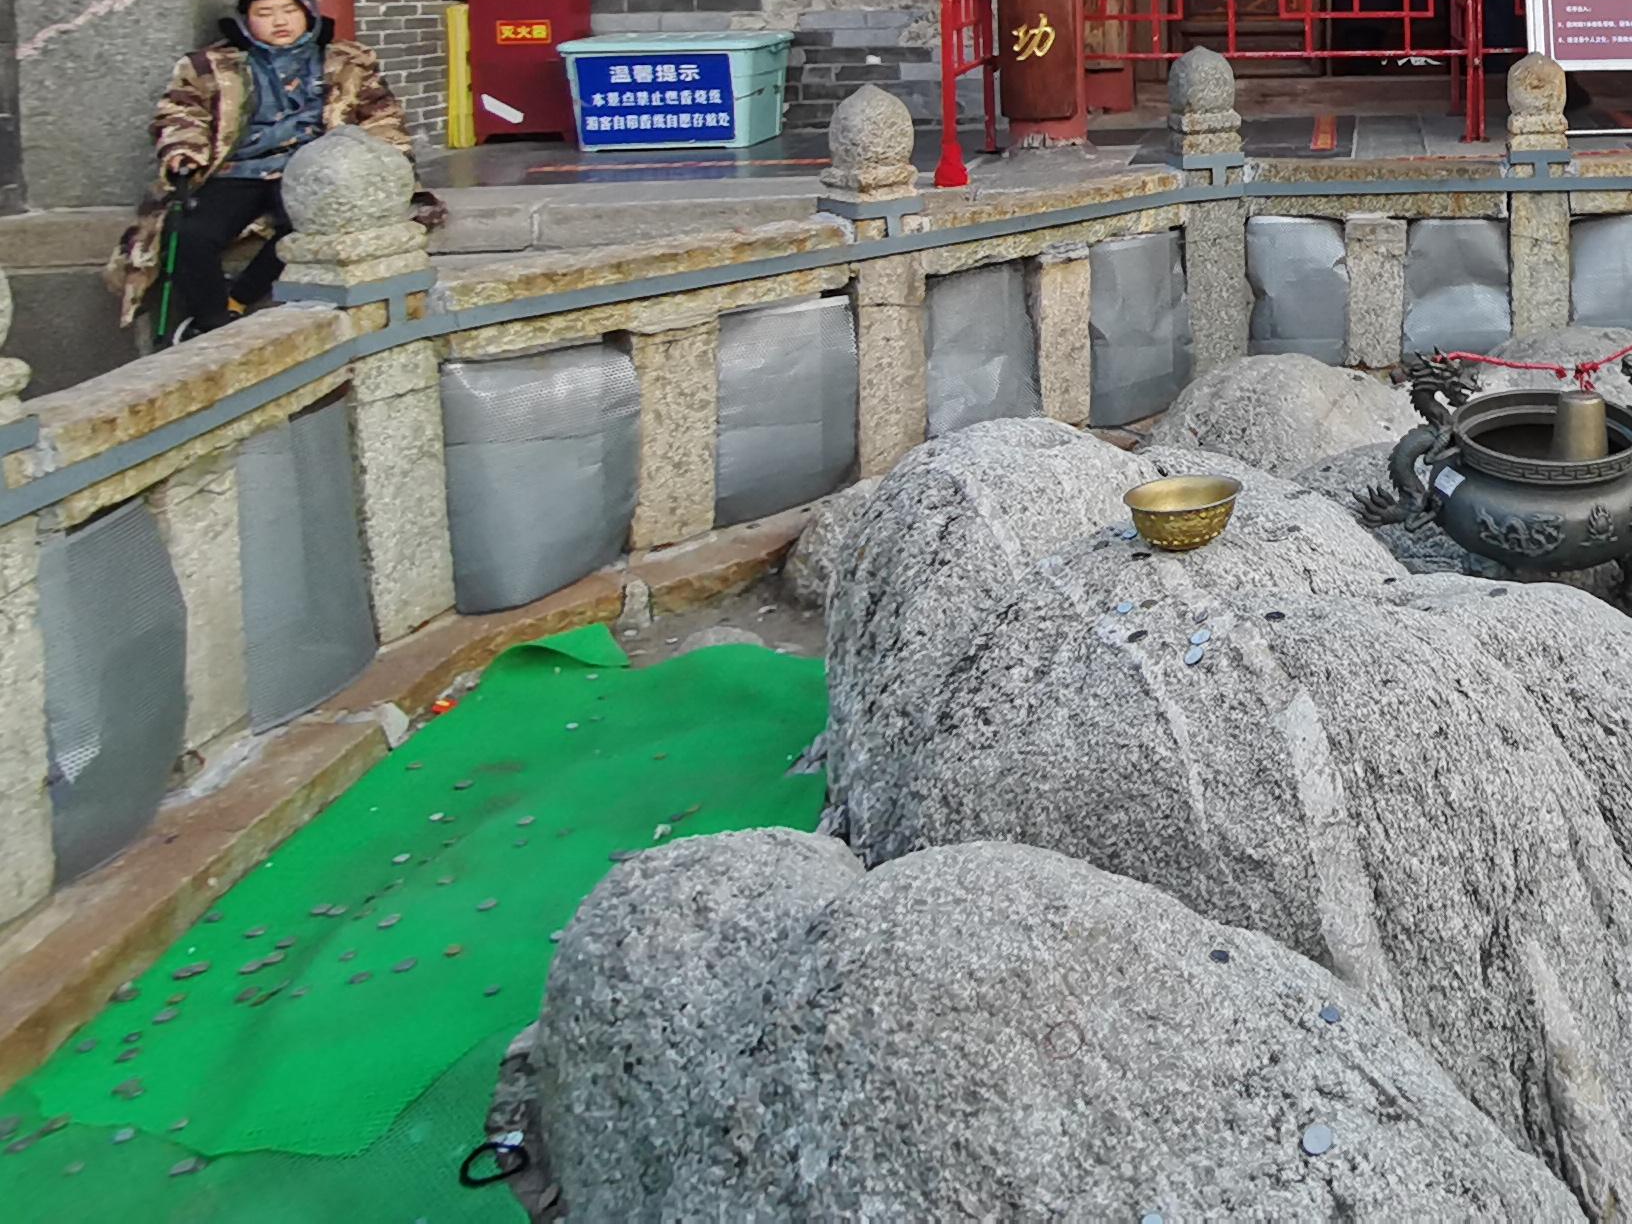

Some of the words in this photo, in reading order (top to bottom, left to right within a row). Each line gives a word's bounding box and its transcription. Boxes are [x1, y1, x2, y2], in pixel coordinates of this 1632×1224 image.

[500, 25, 547, 39] 灭火器
[608, 64, 701, 84] 温馨提示
